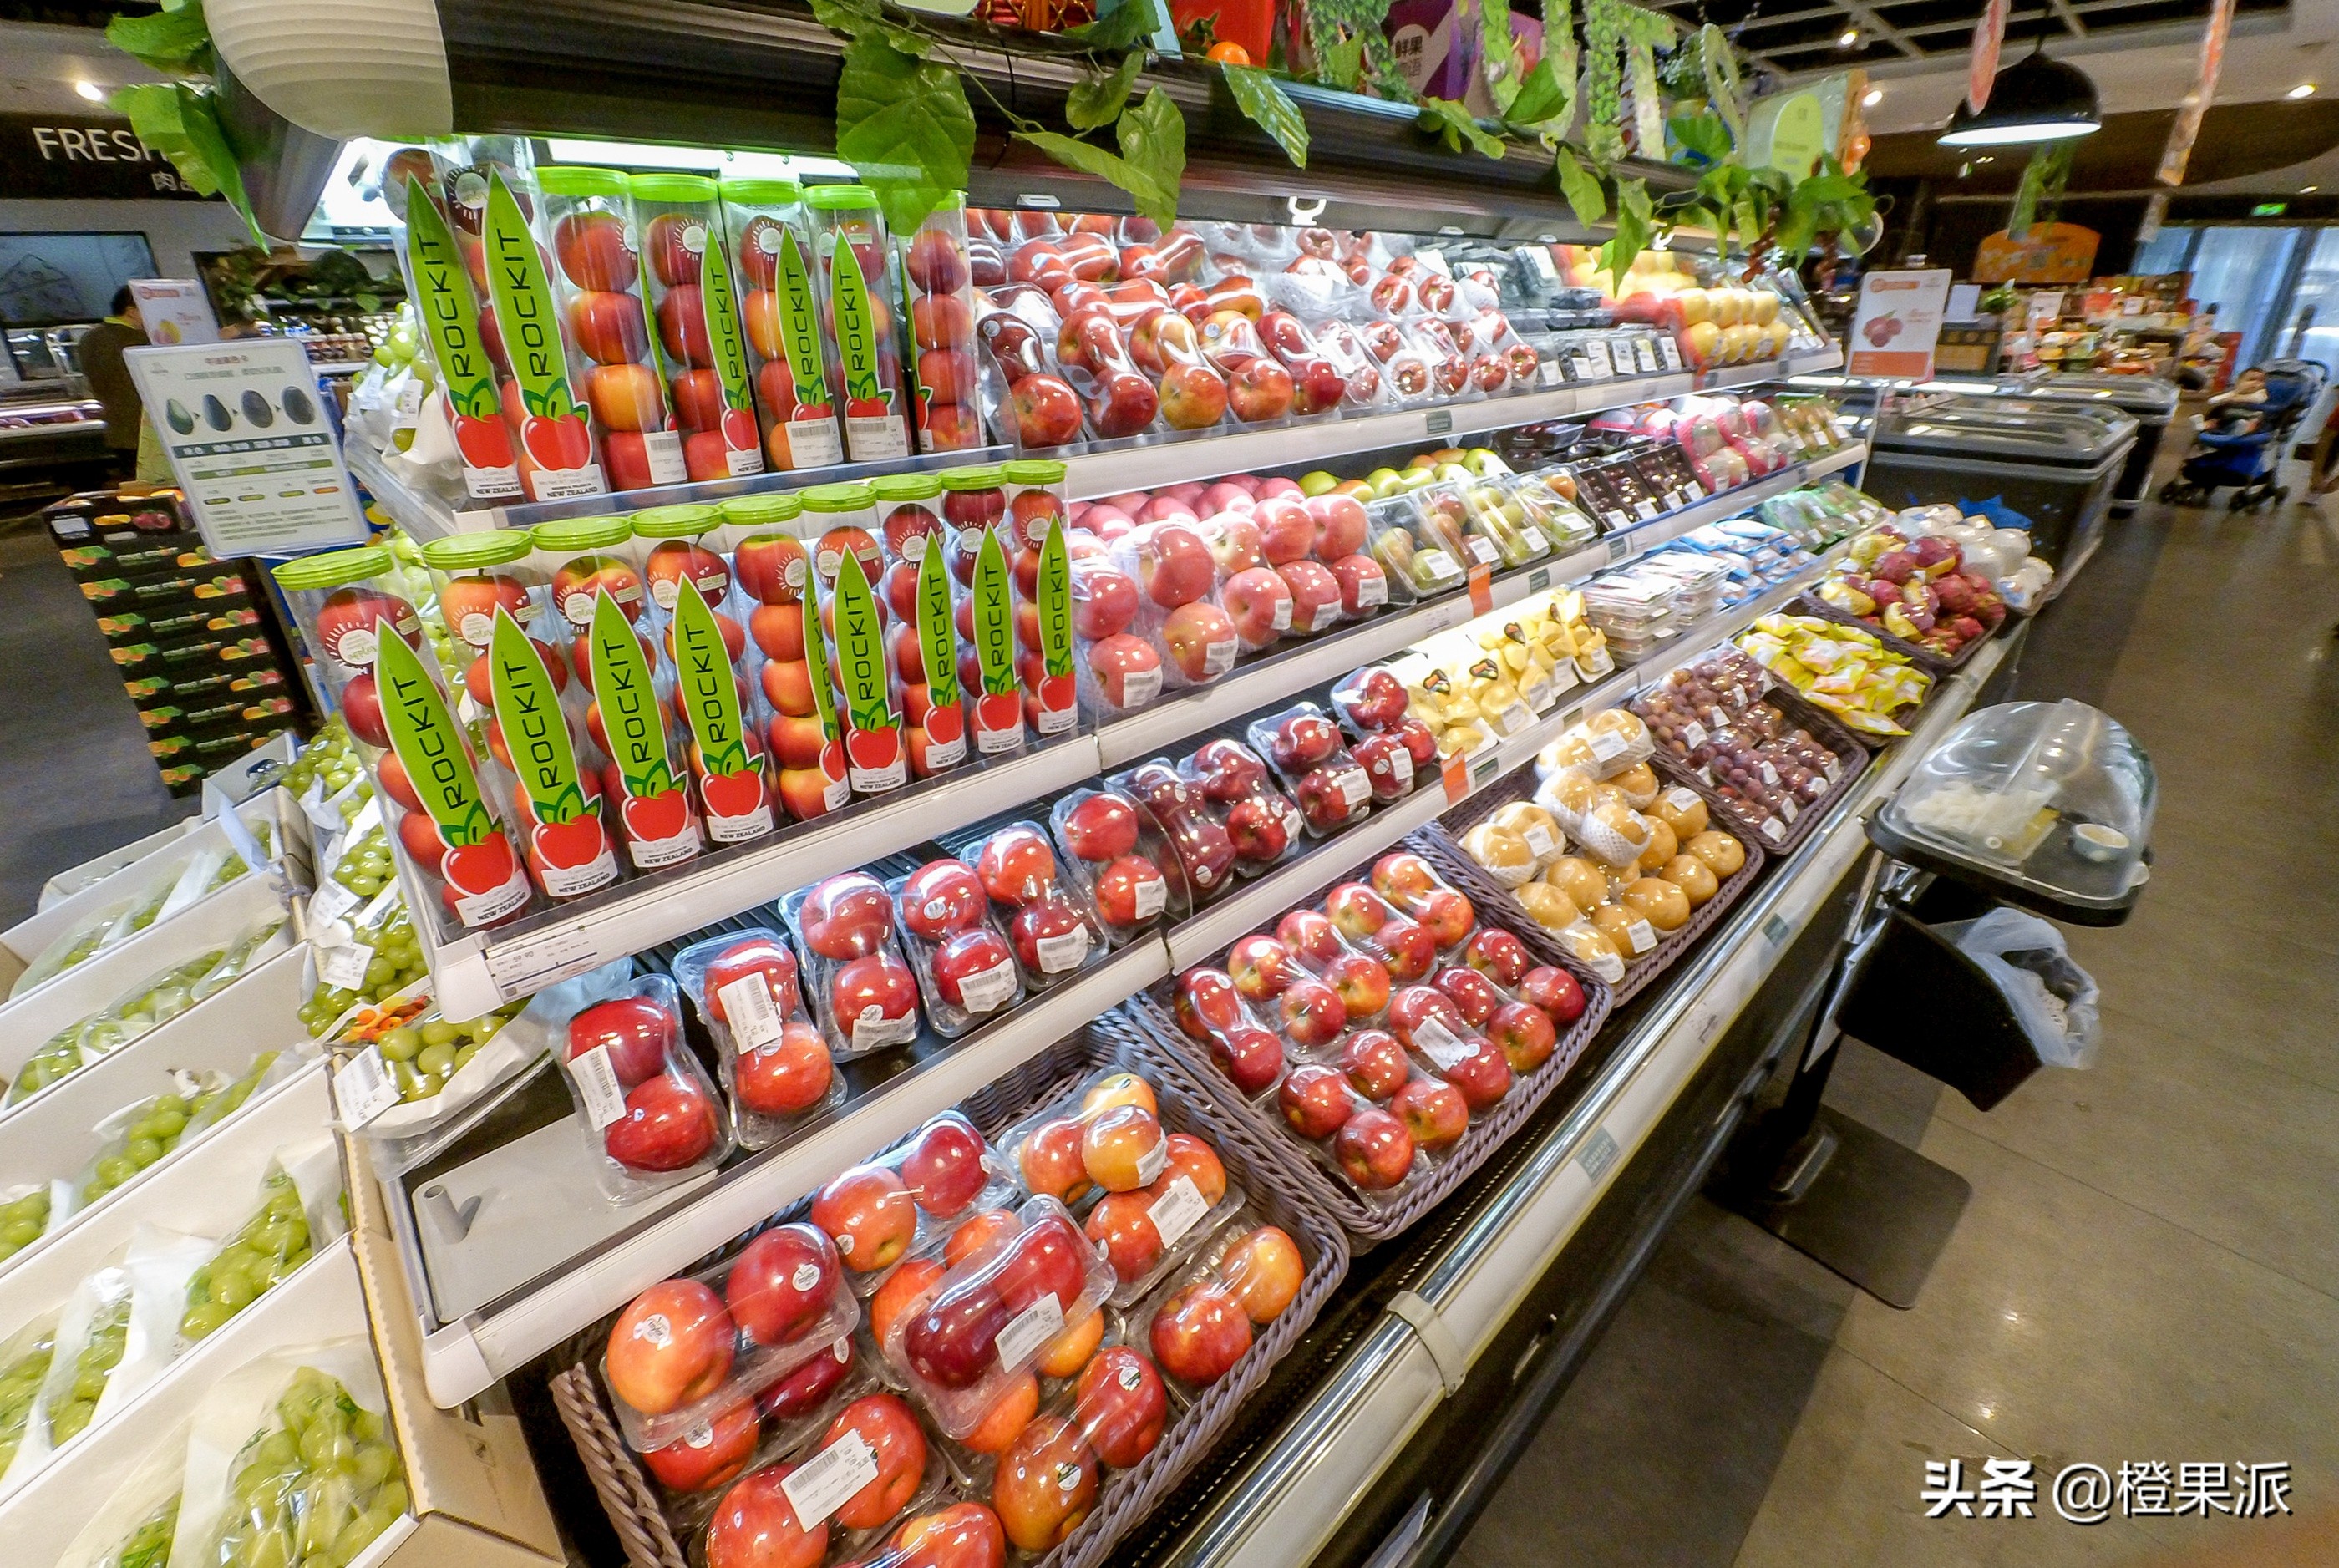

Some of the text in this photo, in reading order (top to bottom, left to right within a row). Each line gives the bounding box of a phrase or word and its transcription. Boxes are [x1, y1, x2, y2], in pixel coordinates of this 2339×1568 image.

[416, 232, 475, 378] ROCKIT
[496, 226, 552, 378] ROCKIT
[711, 266, 742, 380] ROCKIT
[786, 266, 815, 377] ROCKIT
[838, 269, 866, 373] ROCKIT
[492, 485, 520, 494] ZEALAN
[566, 486, 598, 496] ZEALAND
[844, 591, 875, 701] ROCKIT
[927, 572, 951, 678] ROCKIT
[983, 565, 1006, 667] ROCKIT
[1048, 552, 1065, 651] ROCKIT
[503, 660, 563, 790] ROCKIT
[602, 638, 652, 764] ROCKIT
[685, 622, 728, 743] ROCKIT
[392, 675, 469, 810] ROCKIT
[558, 885, 576, 893] NEW
[578, 873, 611, 890] ZEALAND
[662, 846, 693, 861] ZEALAND
[736, 825, 766, 838] ZEALAND
[477, 911, 497, 921] NEW
[499, 891, 527, 914] ZEALAND
